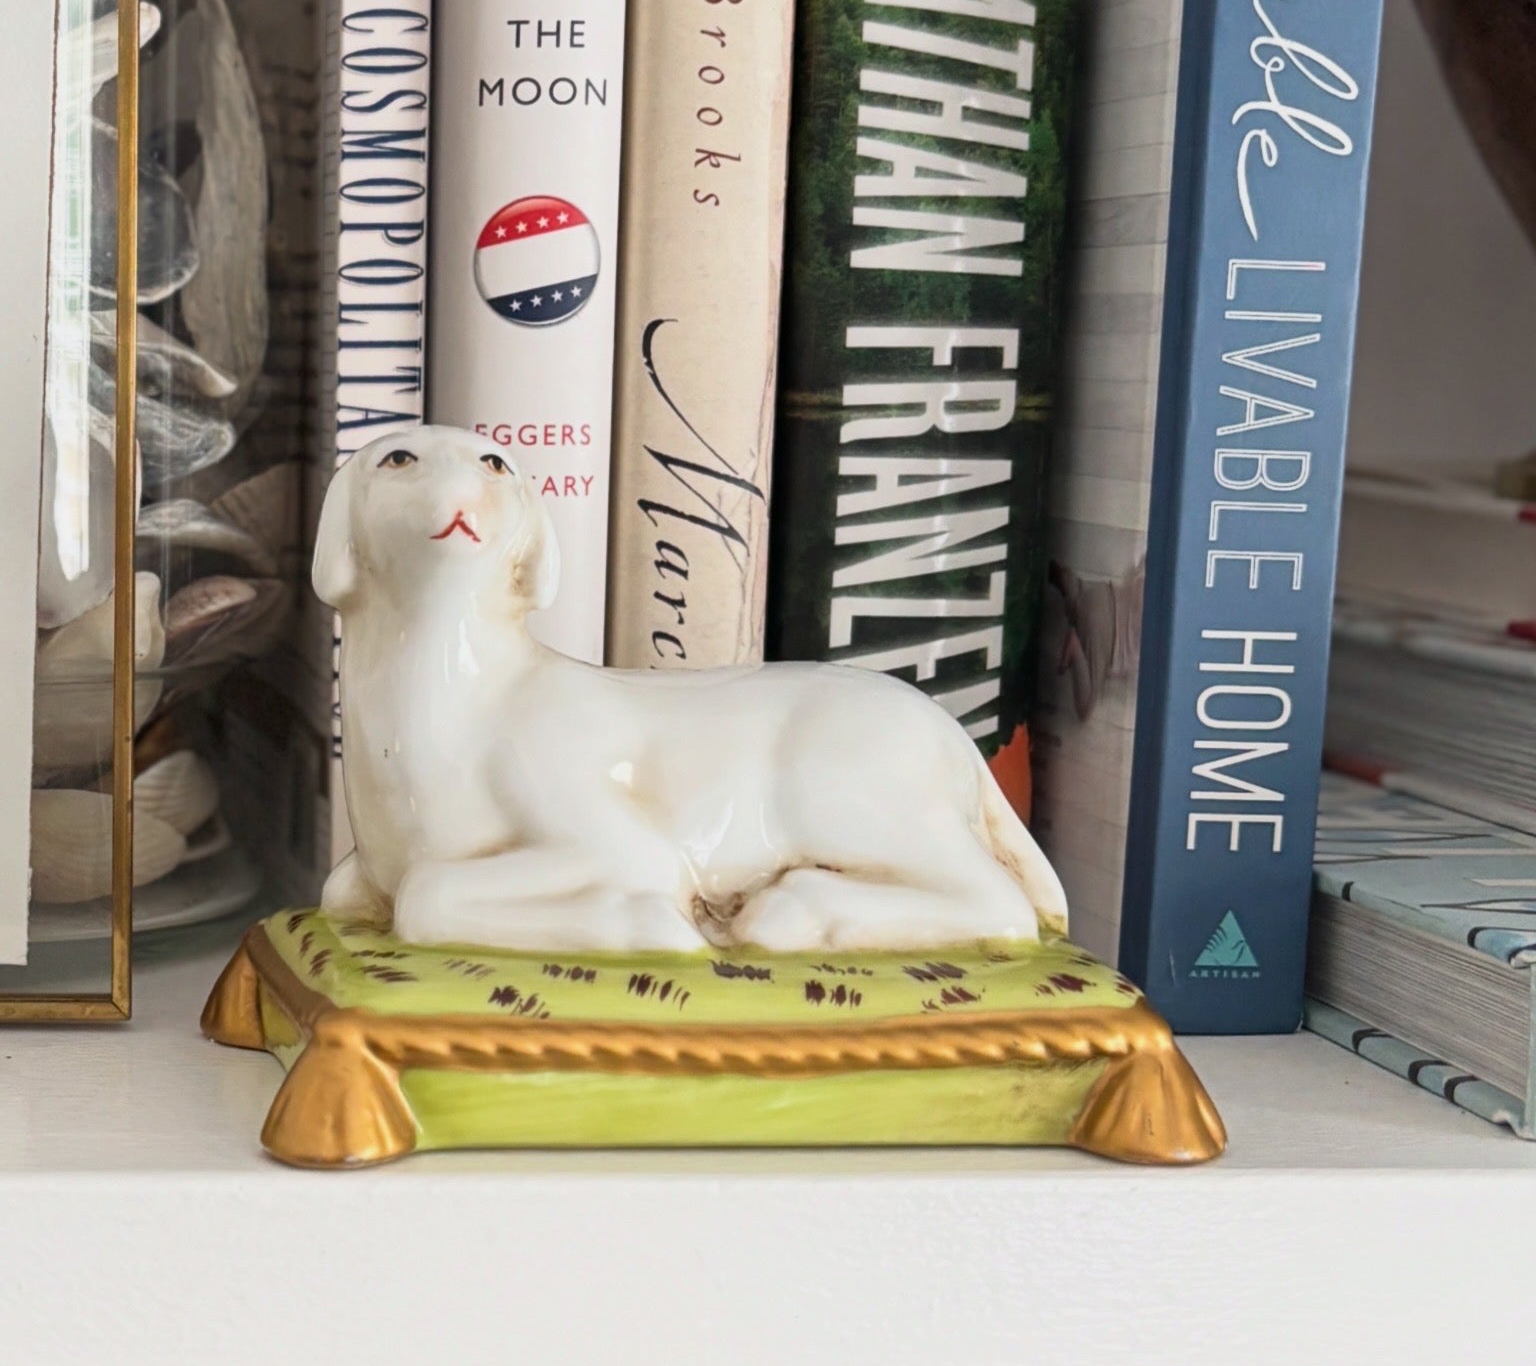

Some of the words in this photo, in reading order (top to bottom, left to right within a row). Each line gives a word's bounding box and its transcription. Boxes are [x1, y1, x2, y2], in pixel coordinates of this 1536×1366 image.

[478, 77, 608, 107] MOON
[506, 19, 586, 50] THE
[336, 7, 430, 471] COSMOPOLITA
[636, 318, 766, 669] Marc
[1203, 258, 1328, 592] LIVABLE
[1185, 628, 1298, 855] HOME
